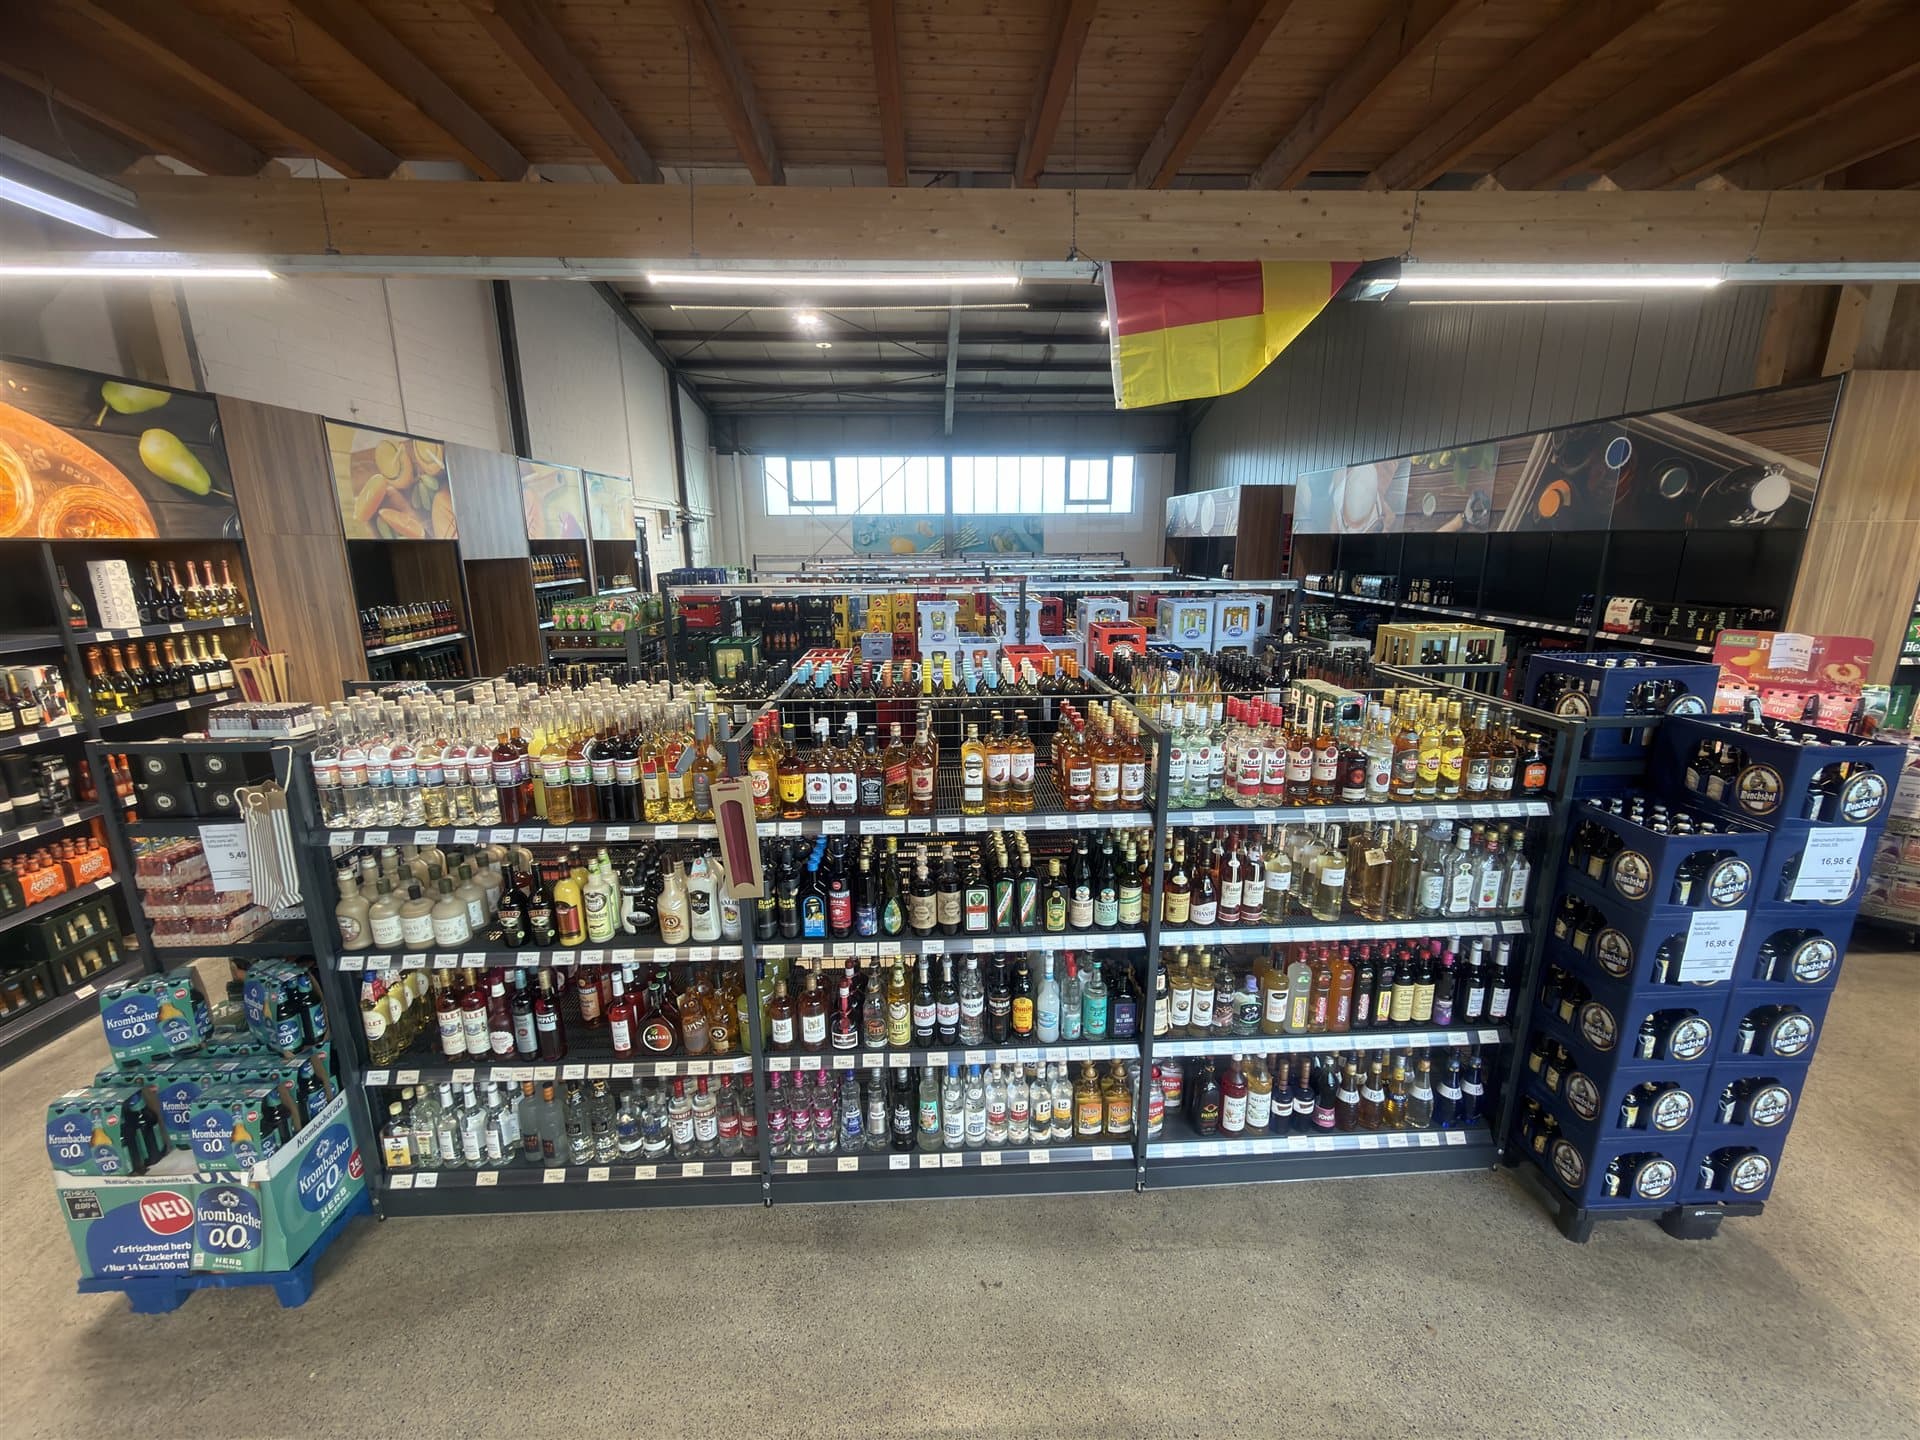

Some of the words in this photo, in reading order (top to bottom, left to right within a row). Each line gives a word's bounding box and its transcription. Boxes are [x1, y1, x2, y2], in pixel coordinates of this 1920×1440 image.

[228, 851, 247, 859] 5,49
[1821, 858, 1844, 866] 16,98
[1846, 857, 1853, 865] €
[1705, 939, 1726, 948] 16,98
[106, 1011, 158, 1029] Krombacher
[162, 1101, 191, 1111] Krombac
[48, 1133, 92, 1145] Krombacher
[191, 1128, 232, 1139] Krombacher
[300, 1137, 351, 1194] Krombacher
[143, 1198, 190, 1222] NEU
[197, 1207, 261, 1229] Krombacher
[119, 1244, 170, 1254] Erfrischend
[171, 1241, 192, 1250] herb
[145, 1251, 190, 1260] Zuckerfrei
